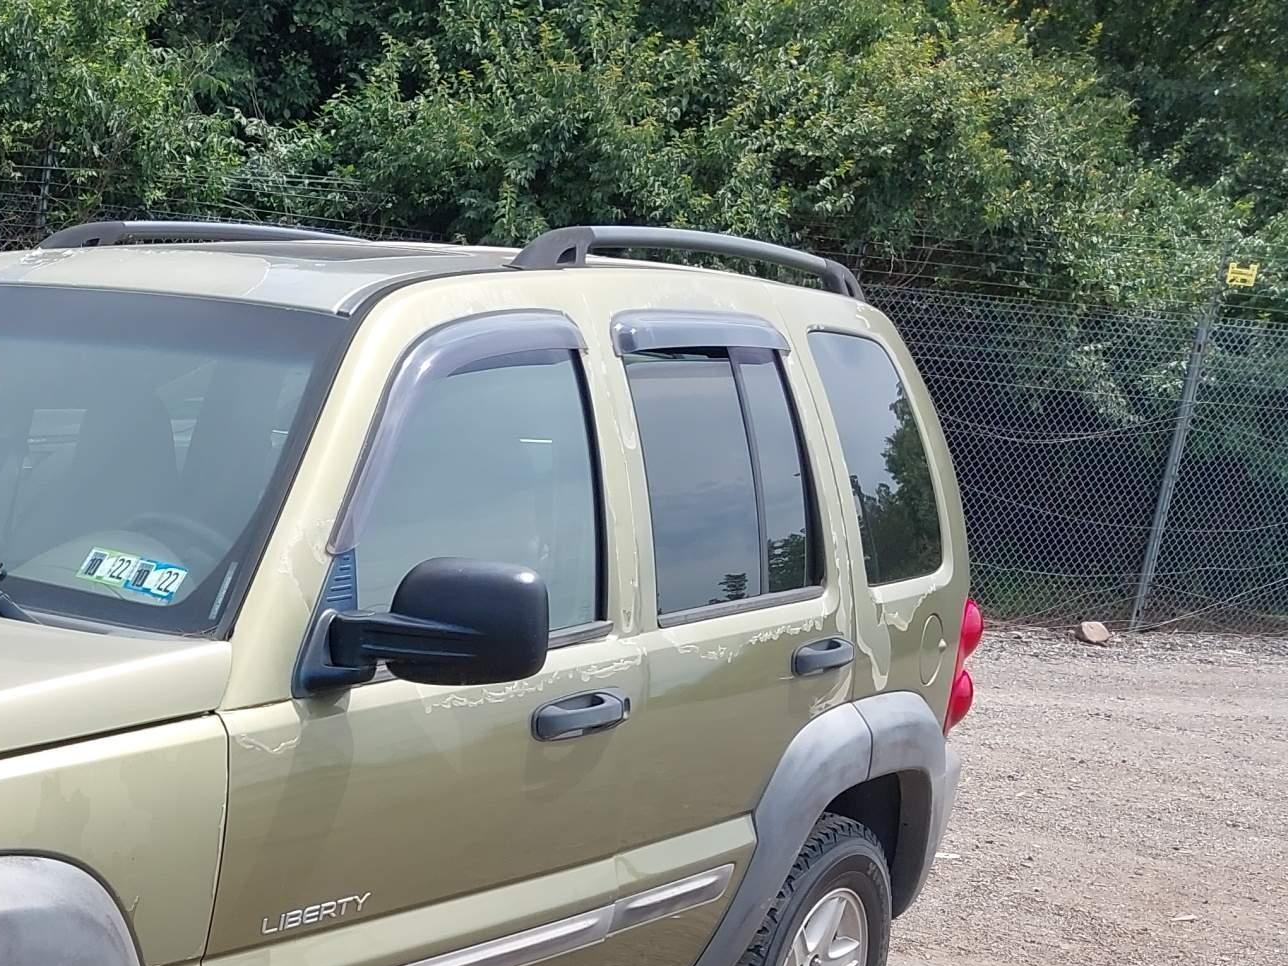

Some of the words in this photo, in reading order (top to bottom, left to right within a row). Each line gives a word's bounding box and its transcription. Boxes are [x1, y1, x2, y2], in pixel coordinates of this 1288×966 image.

[109, 558, 131, 580] 22
[132, 568, 150, 588] 10
[156, 570, 179, 593] 22
[261, 892, 372, 934] LIBERTY
